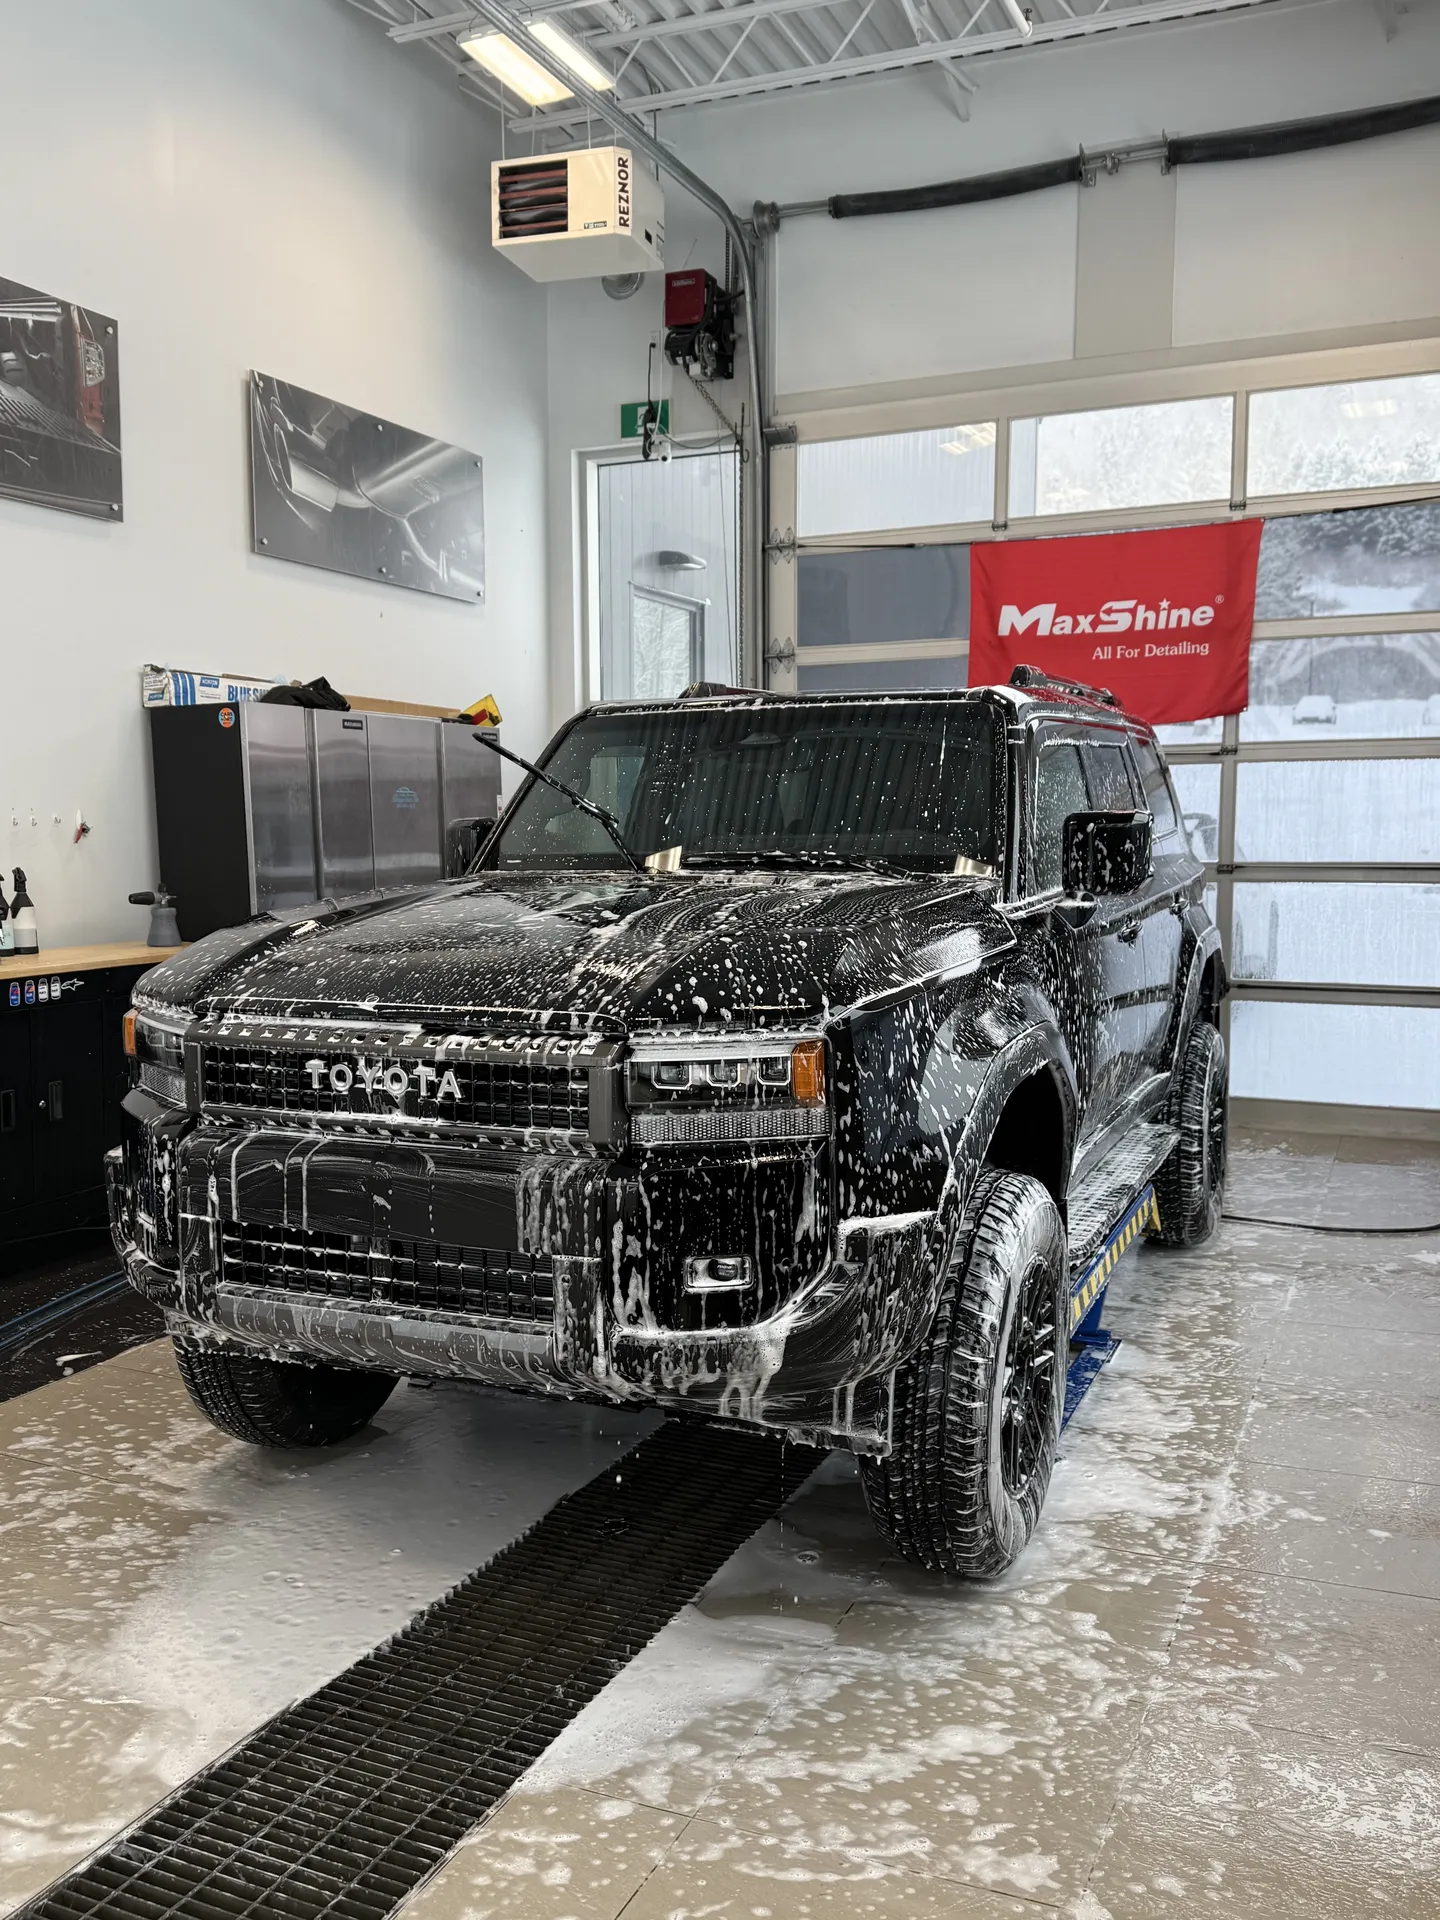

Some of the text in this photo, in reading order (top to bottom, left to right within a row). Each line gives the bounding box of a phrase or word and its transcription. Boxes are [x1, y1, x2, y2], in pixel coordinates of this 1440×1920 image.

[617, 156, 630, 228] REZNOR
[1092, 641, 1210, 660] All For Detailing
[305, 1058, 463, 1099] TOYOTA
